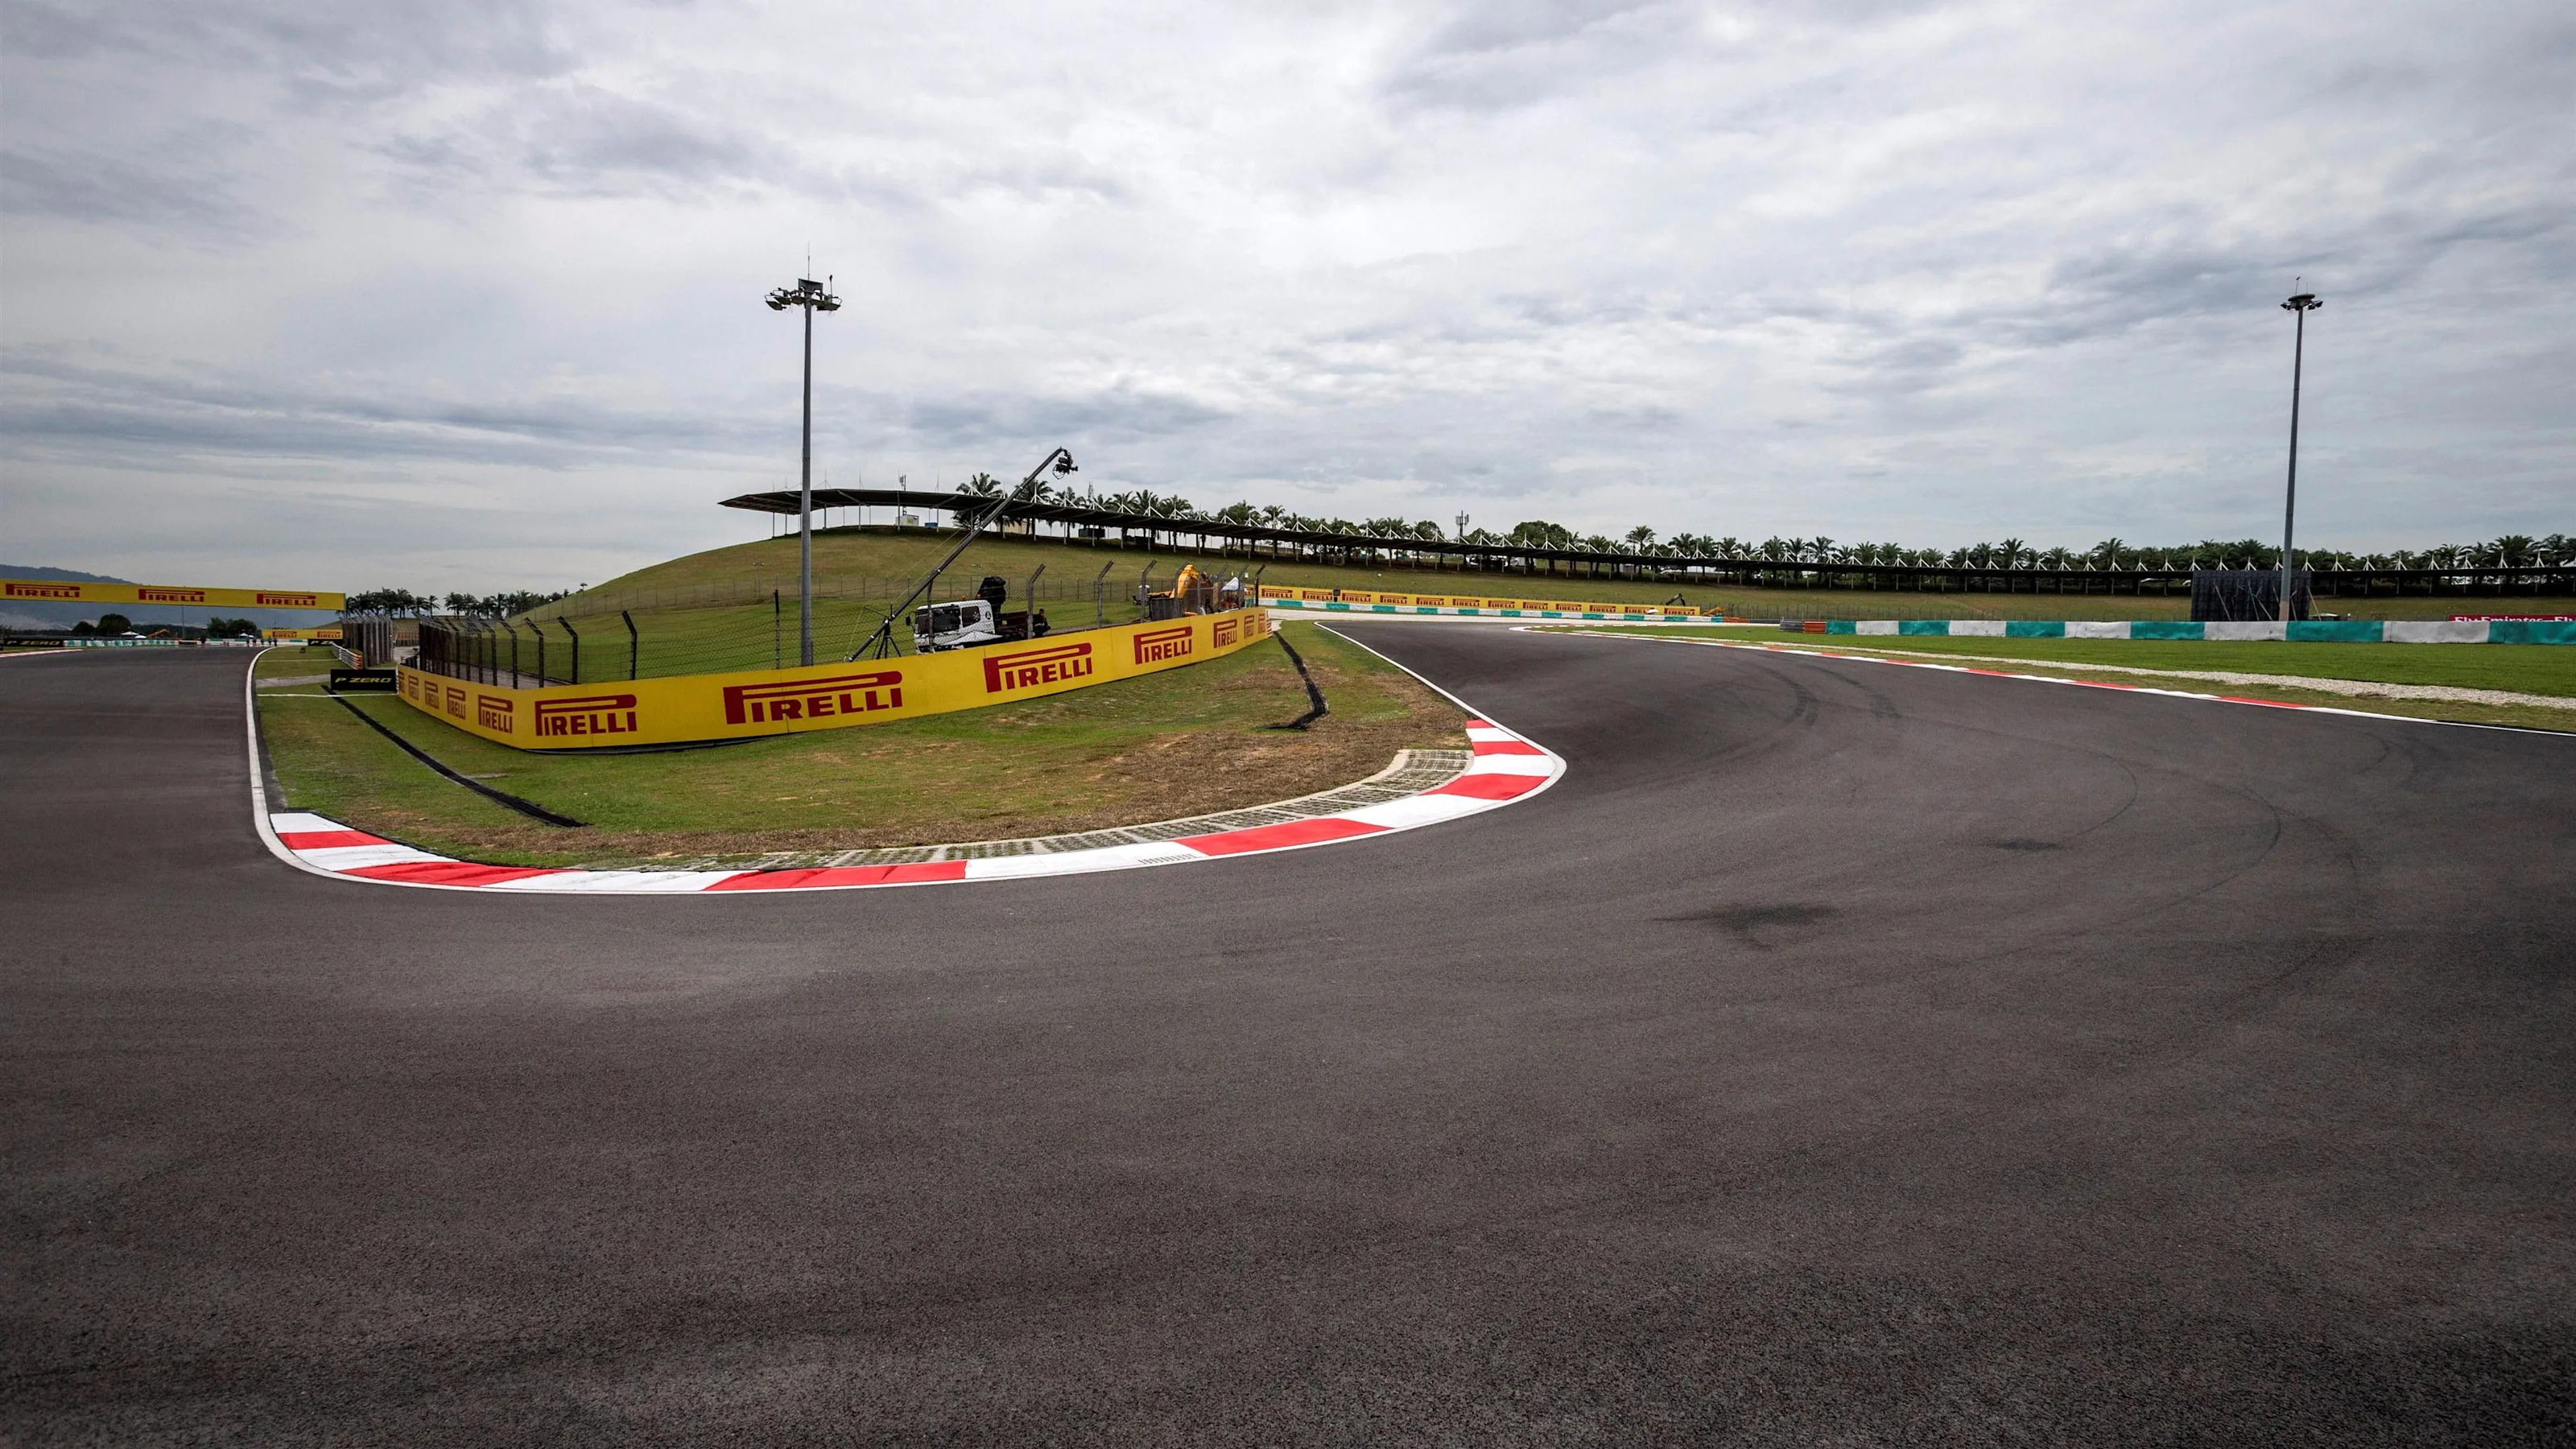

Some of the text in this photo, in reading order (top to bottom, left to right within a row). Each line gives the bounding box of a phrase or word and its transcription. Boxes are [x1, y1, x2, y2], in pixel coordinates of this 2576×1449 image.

[6, 584, 316, 606] PIRELLI PIRELLI PIRELLI
[1261, 588, 1293, 598] PIRELLI
[1302, 590, 1332, 601] PIRELLI
[1342, 592, 1371, 602] PIRELLI
[1380, 595, 1407, 605] PIRELLI
[1416, 597, 1444, 606] PIRELLI
[1453, 598, 1480, 608] PIRELLI
[1488, 600, 1515, 609] PIRELLI
[1522, 601, 1549, 610] PIRELLI
[1555, 603, 1582, 612] PIRELLI
[1589, 605, 1616, 613] PIRELLI
[272, 630, 341, 638] PIRELLI PIRELLI
[446, 687, 466, 720] PIRELLI
[478, 695, 513, 734] PIRELLI
[535, 694, 638, 737] PIRELLI
[722, 670, 903, 724] PIRELLI
[982, 642, 1092, 693] PIRELLI
[1133, 625, 1193, 664] PIRELLI
[1214, 619, 1237, 649] PIRELLI
